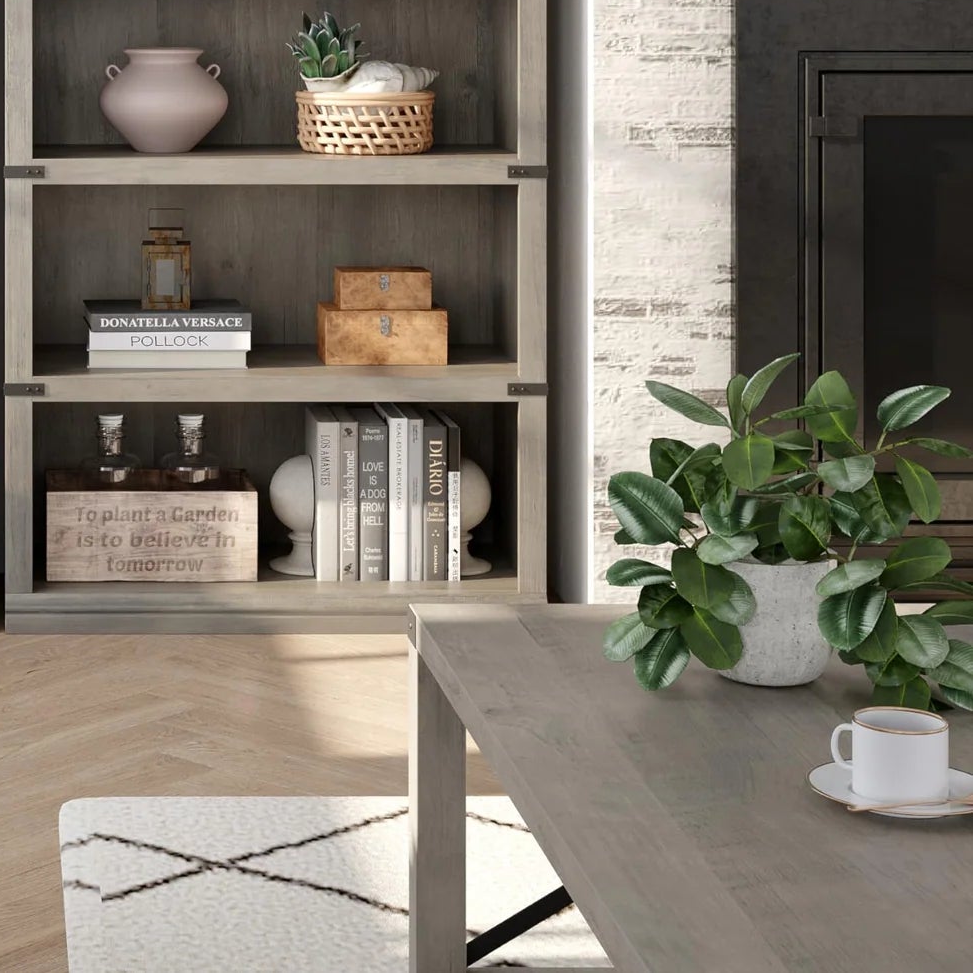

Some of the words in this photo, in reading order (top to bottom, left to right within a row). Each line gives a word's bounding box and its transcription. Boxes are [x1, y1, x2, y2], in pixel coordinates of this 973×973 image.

[100, 318, 179, 328] DONATELLA
[181, 317, 243, 327] VERSACE
[130, 336, 209, 347] POLLOCK
[320, 434, 330, 449] LOS
[320, 450, 330, 486] AMANTES
[362, 462, 384, 472] LOVE
[428, 440, 446, 496] DIÁRIO
[369, 475, 377, 485] IS
[360, 489, 367, 498] A
[368, 489, 386, 498] DOG
[361, 502, 385, 512] FROM
[75, 507, 97, 522] To
[102, 506, 151, 526] plant
[154, 509, 166, 522] a
[171, 506, 240, 522] Garden
[363, 516, 384, 526] HELL
[77, 532, 93, 548] is
[101, 533, 123, 548] to
[130, 532, 209, 548] believe
[215, 532, 236, 548] in
[106, 557, 204, 572] tomorrow
